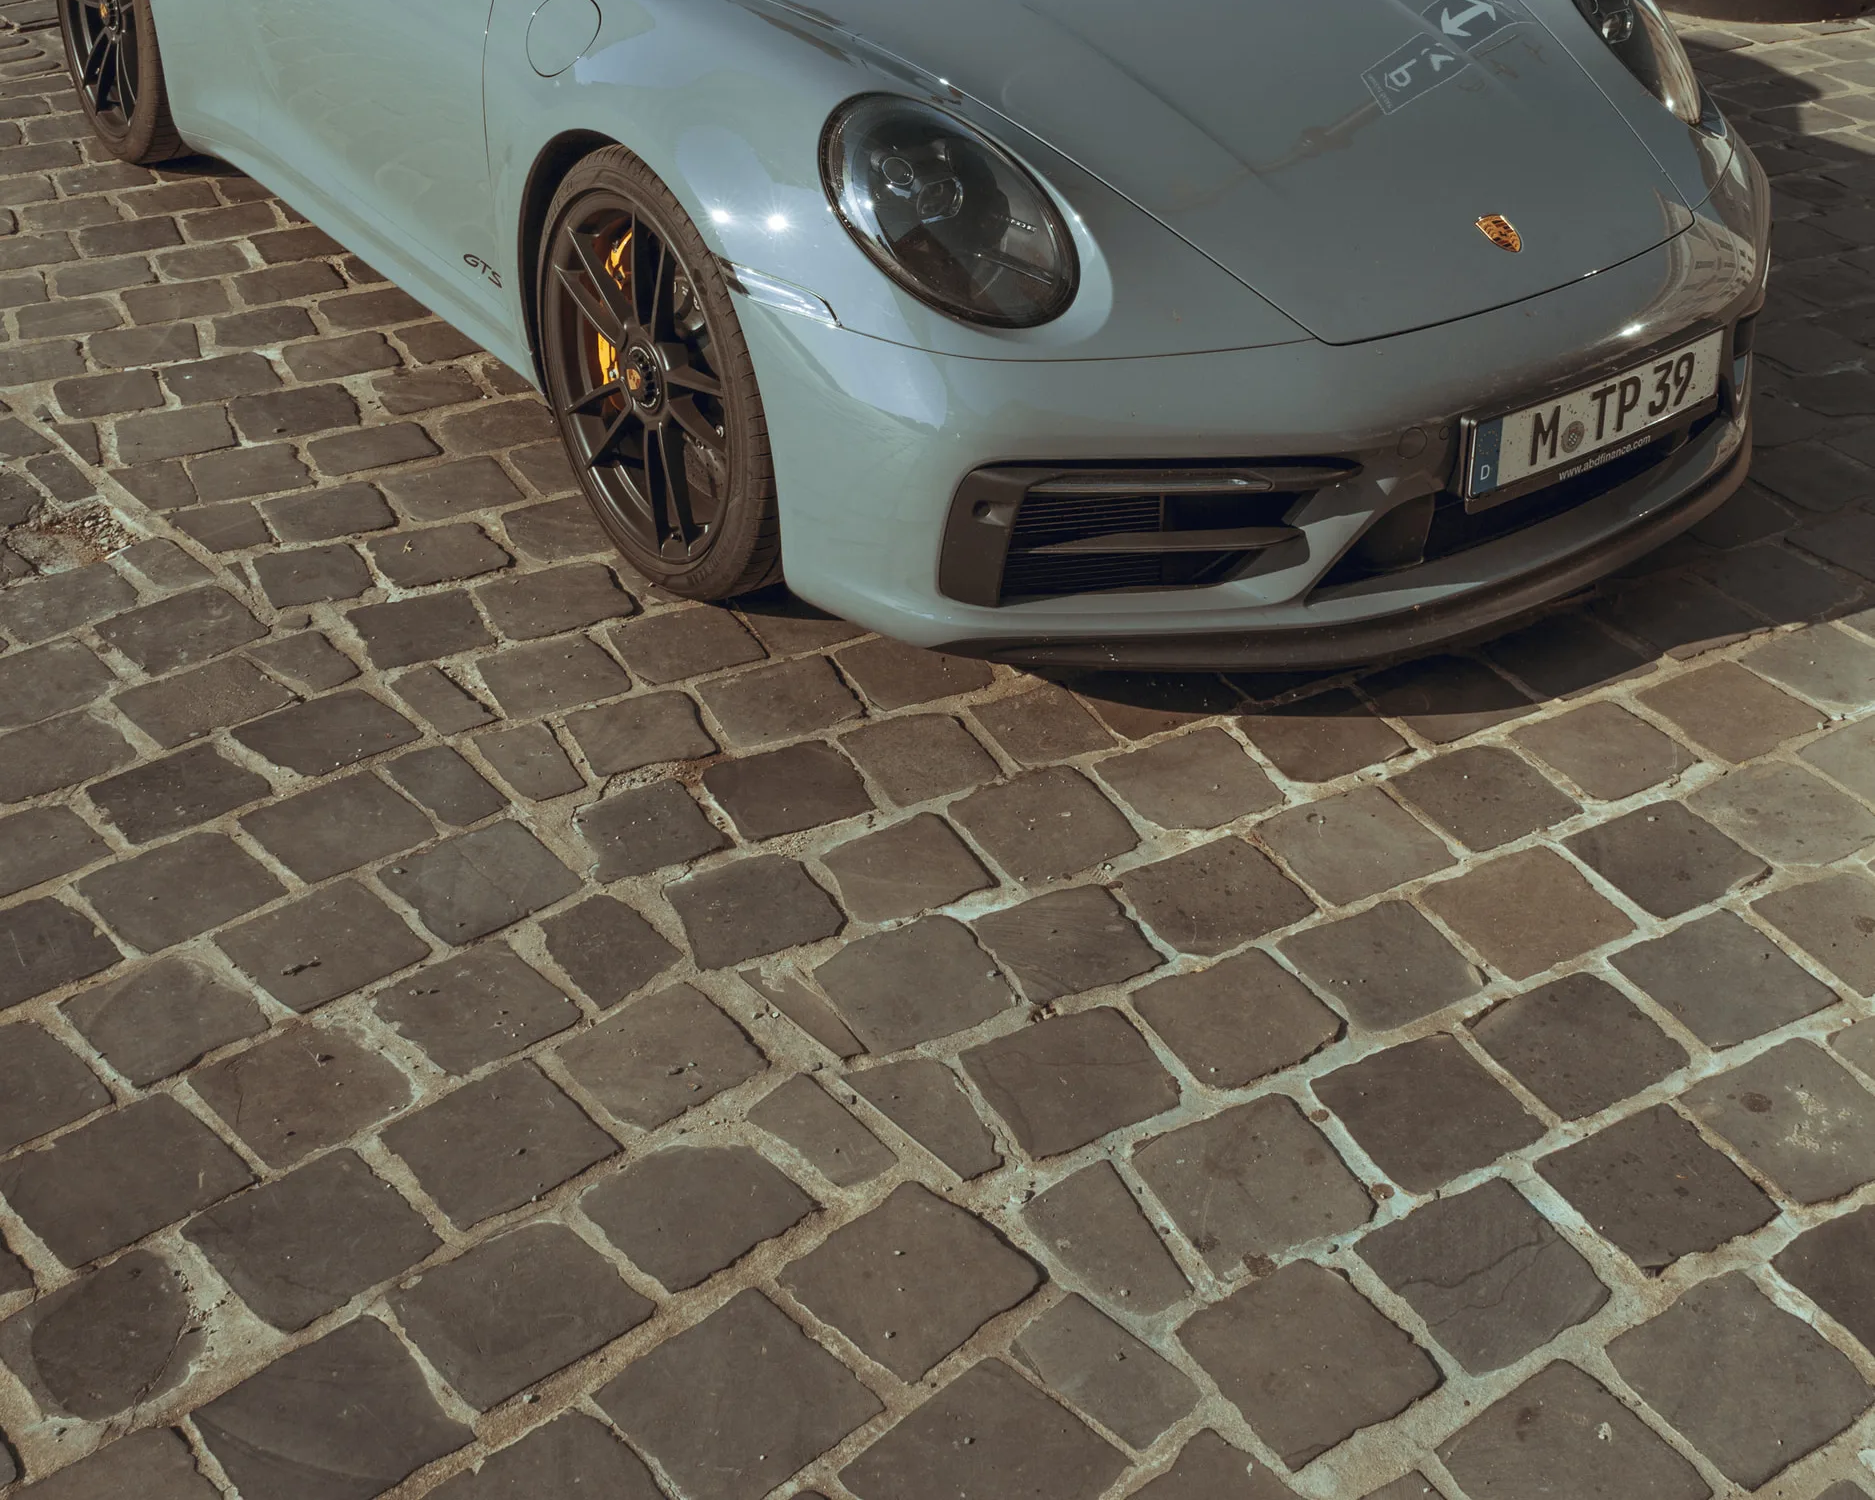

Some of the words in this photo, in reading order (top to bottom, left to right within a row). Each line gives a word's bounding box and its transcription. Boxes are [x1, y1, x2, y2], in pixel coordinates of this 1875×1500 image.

[463, 253, 502, 289] GTS
[1529, 405, 1561, 466] M
[1592, 375, 1641, 441] TP
[1648, 351, 1695, 417] 39
[1480, 464, 1491, 480] D
[1558, 434, 1651, 481] www.abdfinance.com
